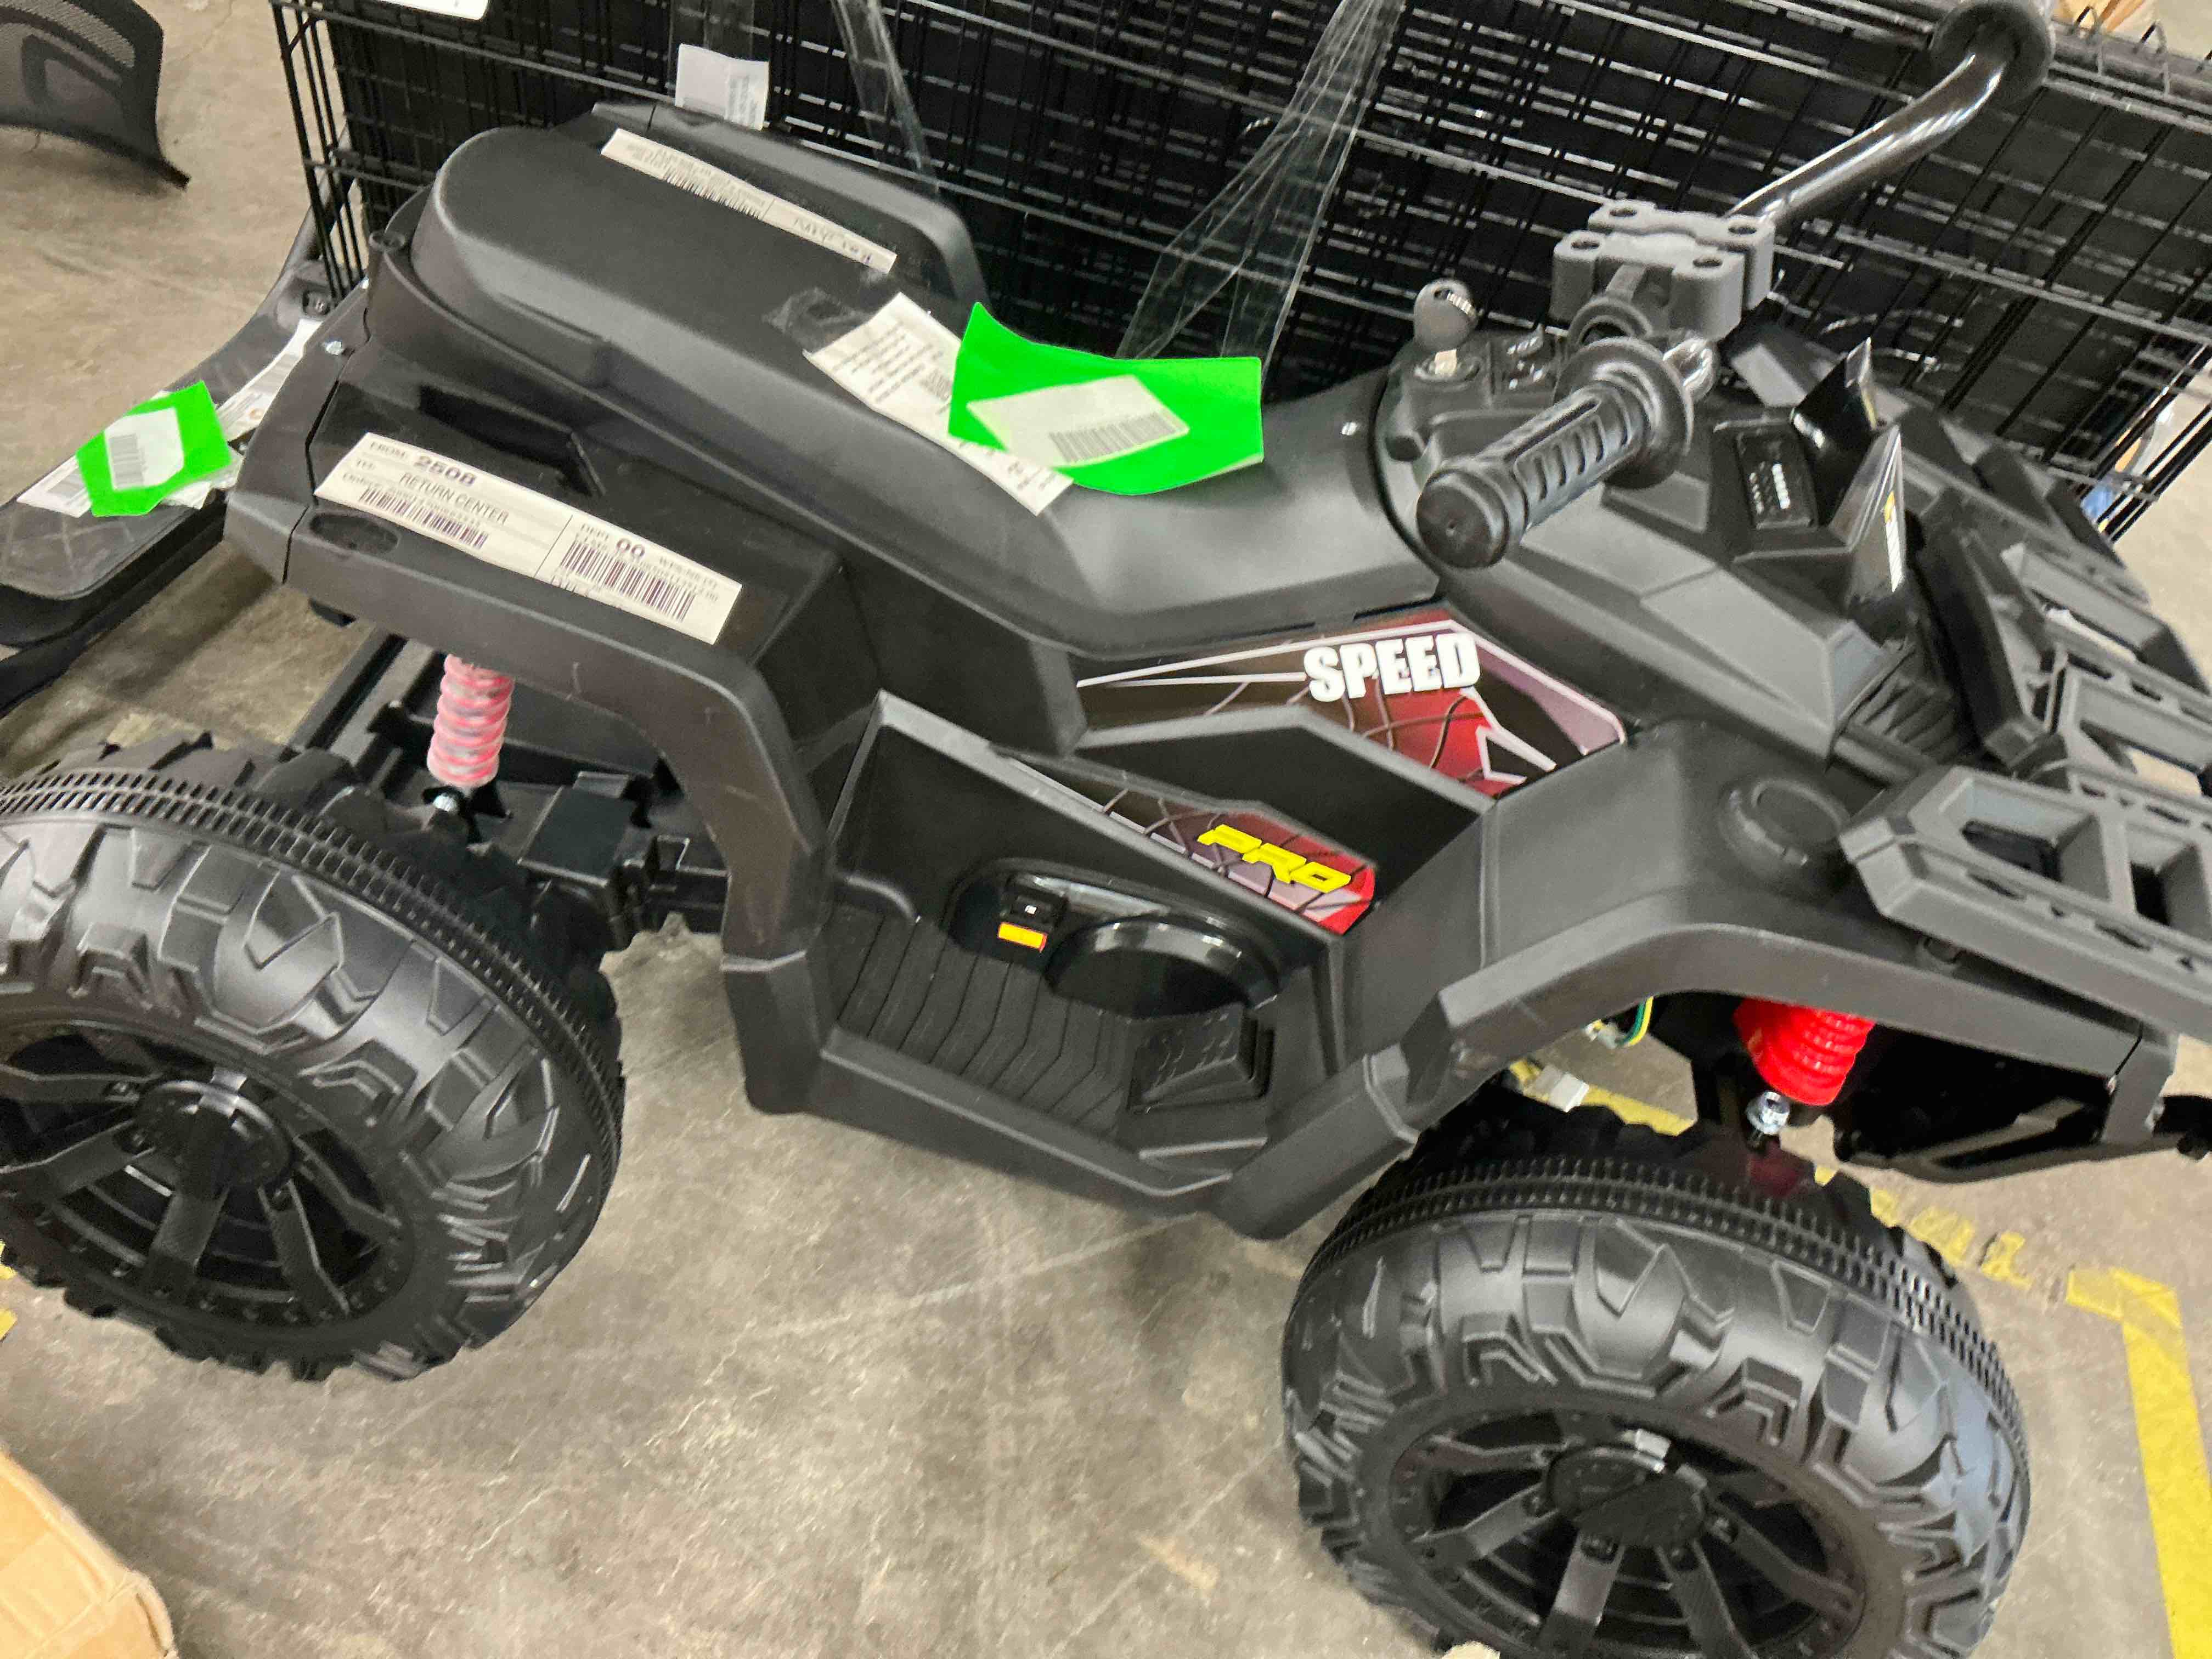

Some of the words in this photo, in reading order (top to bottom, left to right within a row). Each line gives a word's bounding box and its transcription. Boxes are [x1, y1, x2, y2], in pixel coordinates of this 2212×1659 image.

[399, 472, 453, 504] RETURN
[452, 493, 510, 525] CENTER
[1304, 632, 1480, 702] SPEED
[1197, 823, 1352, 894] PRO
